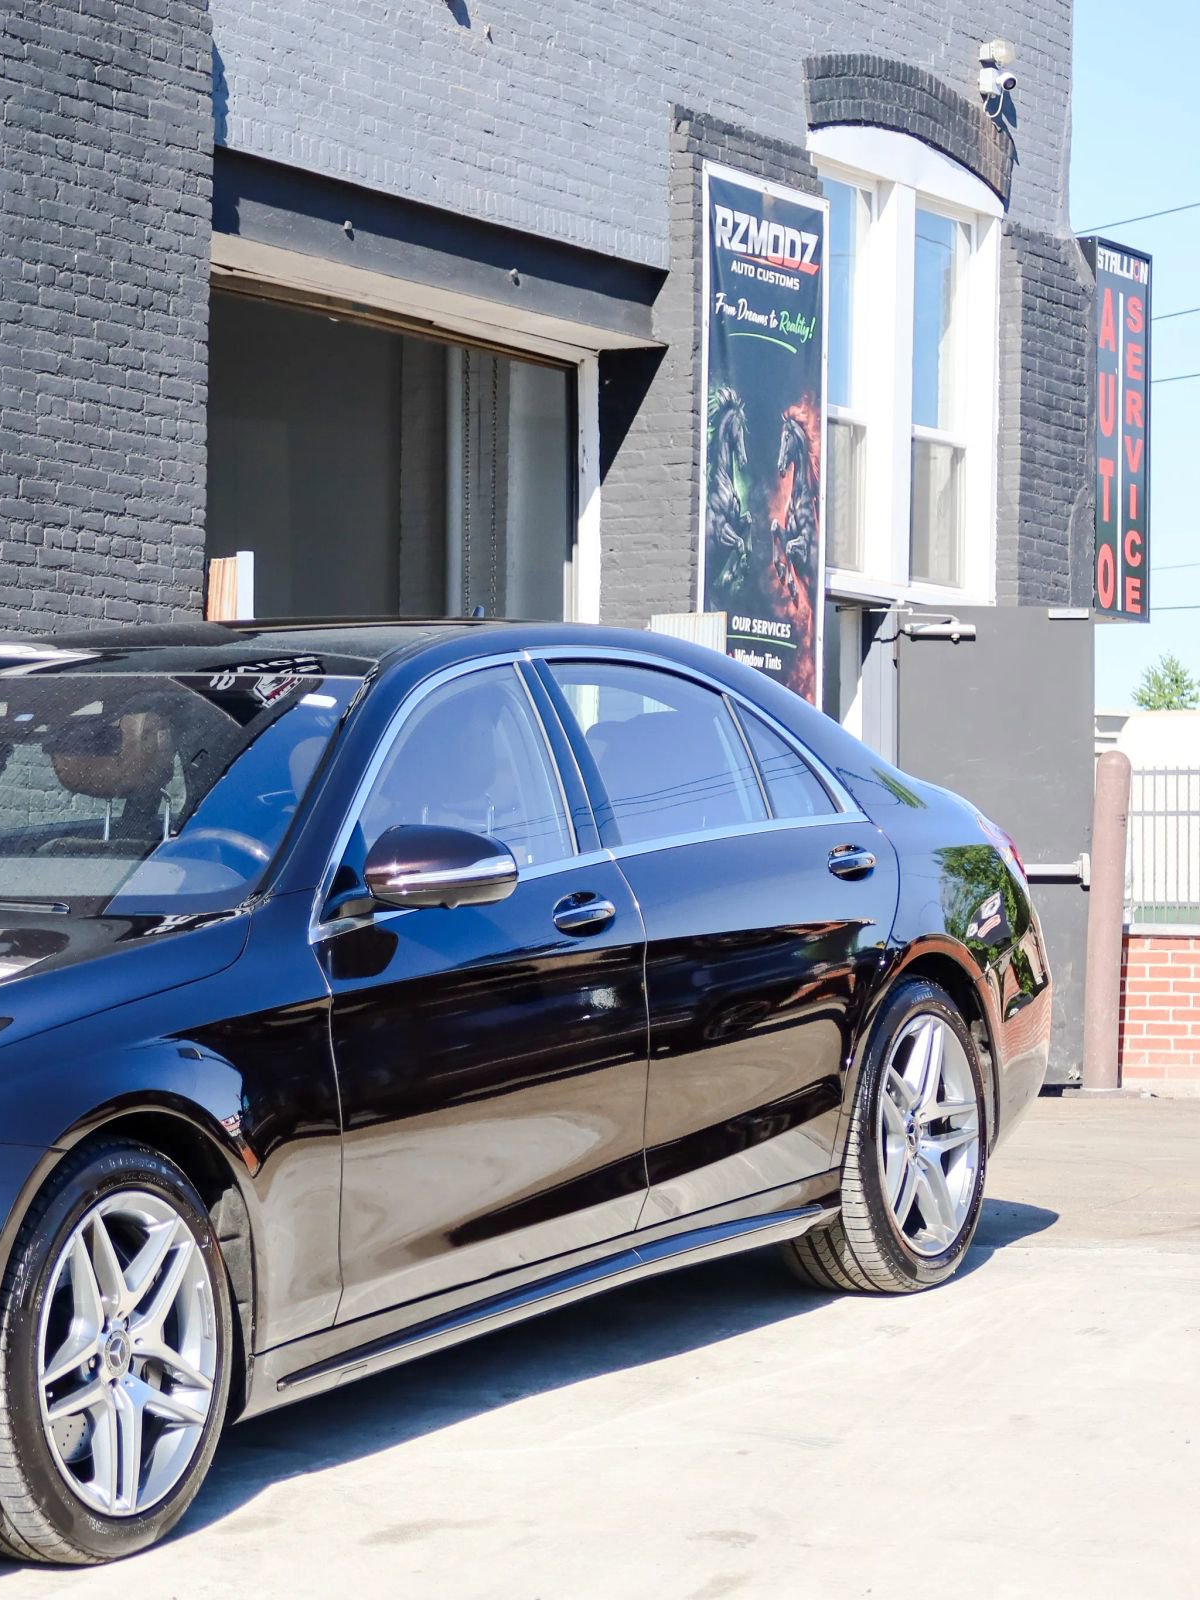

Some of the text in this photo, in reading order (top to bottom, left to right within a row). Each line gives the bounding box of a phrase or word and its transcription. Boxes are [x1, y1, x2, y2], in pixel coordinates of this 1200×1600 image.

[715, 204, 819, 276] RZMODZ
[731, 260, 799, 290] AUTO CUSTOMS
[1098, 247, 1148, 284] STALLION
[715, 292, 816, 343] From Dreams to Reality!
[1097, 287, 1116, 609] AUTO
[1124, 295, 1144, 614] SERVICE
[732, 615, 791, 639] OUR SERVICES
[735, 648, 782, 670] Window Tints
